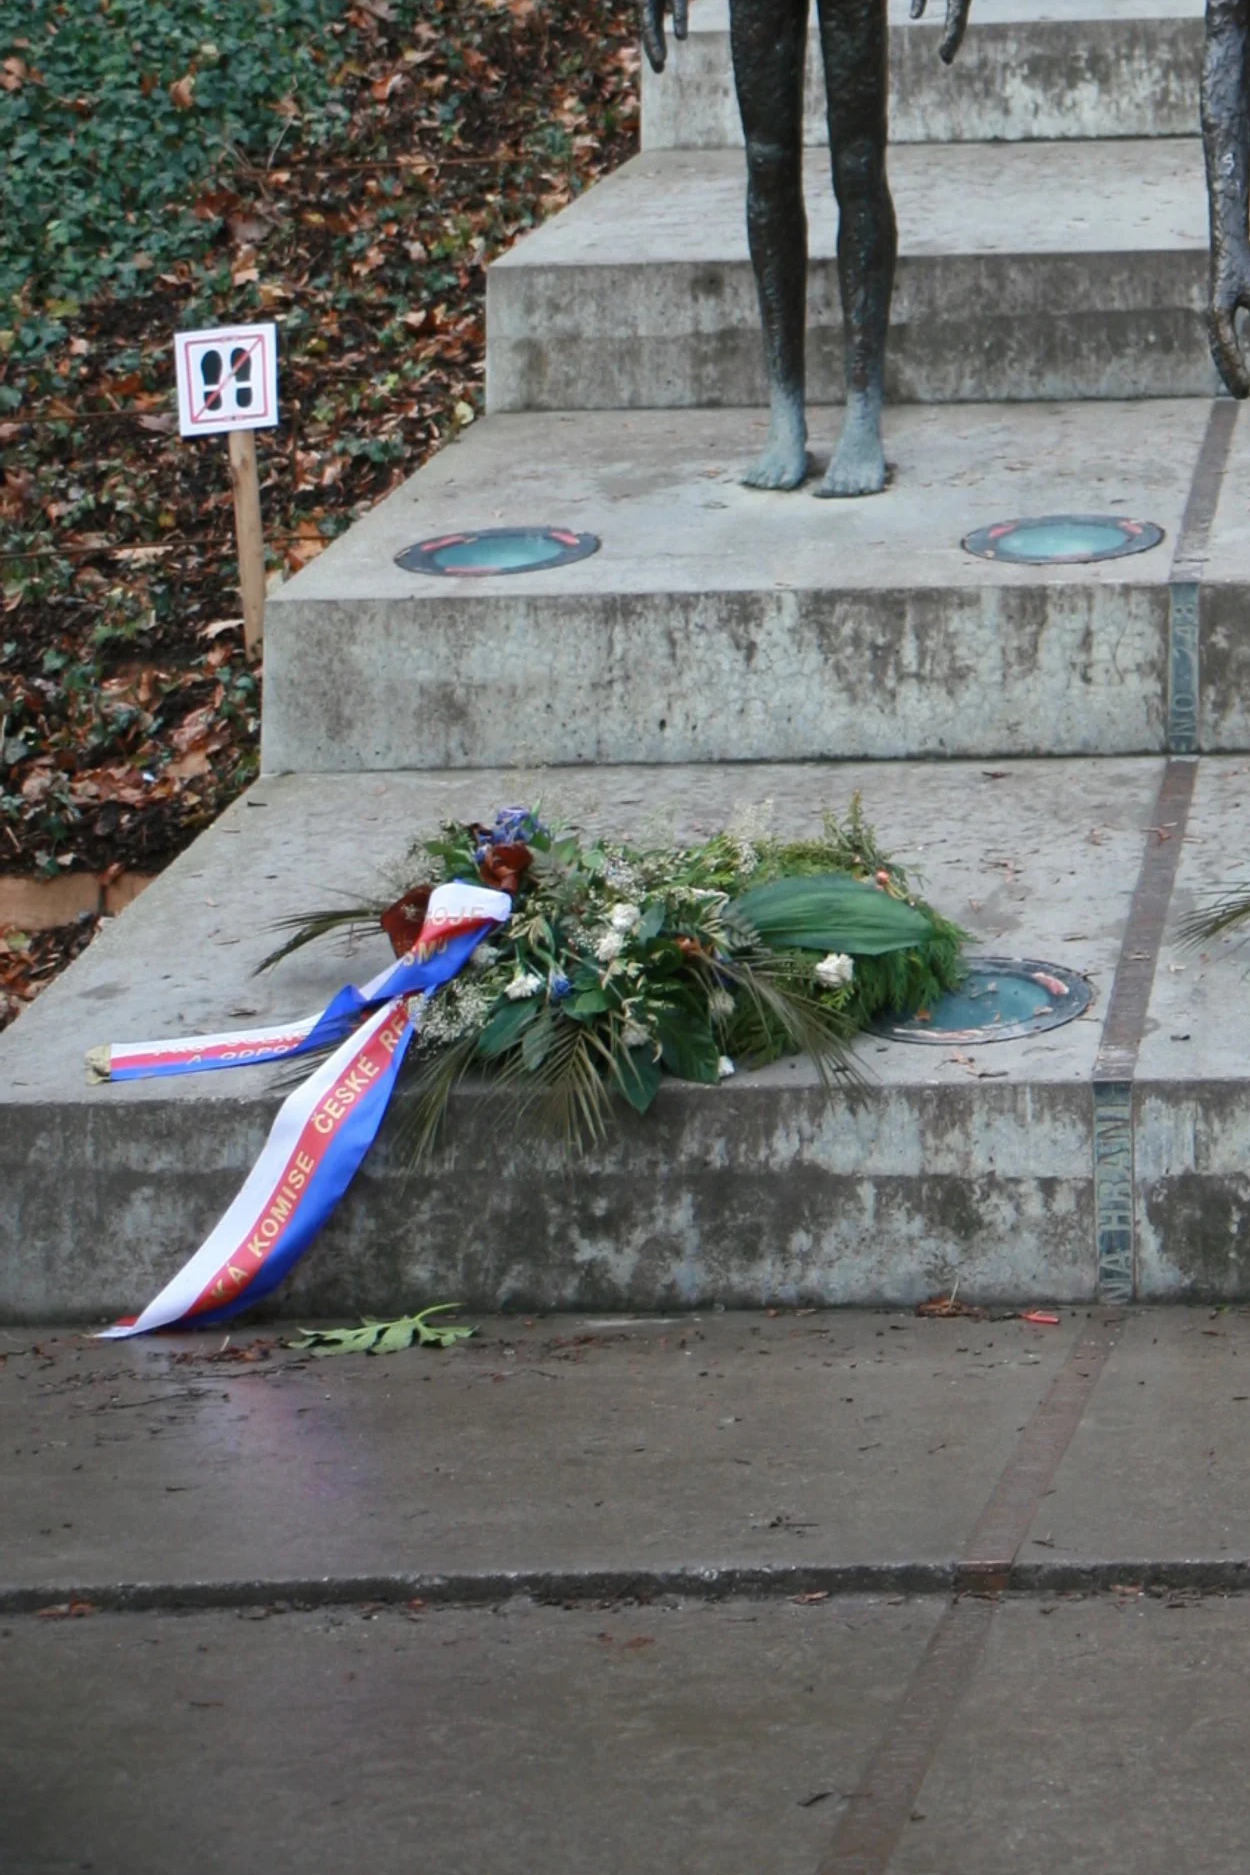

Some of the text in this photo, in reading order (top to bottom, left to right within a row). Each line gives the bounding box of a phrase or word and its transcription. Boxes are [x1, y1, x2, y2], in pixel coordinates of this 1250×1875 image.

[426, 906, 485, 926] OJE
[221, 1044, 298, 1060] ODPO
[207, 1262, 248, 1301] KÁ
[247, 1151, 315, 1258] KOMISE
[311, 1054, 380, 1134] ČESKÉ
[1098, 1248, 1132, 1305] NA
